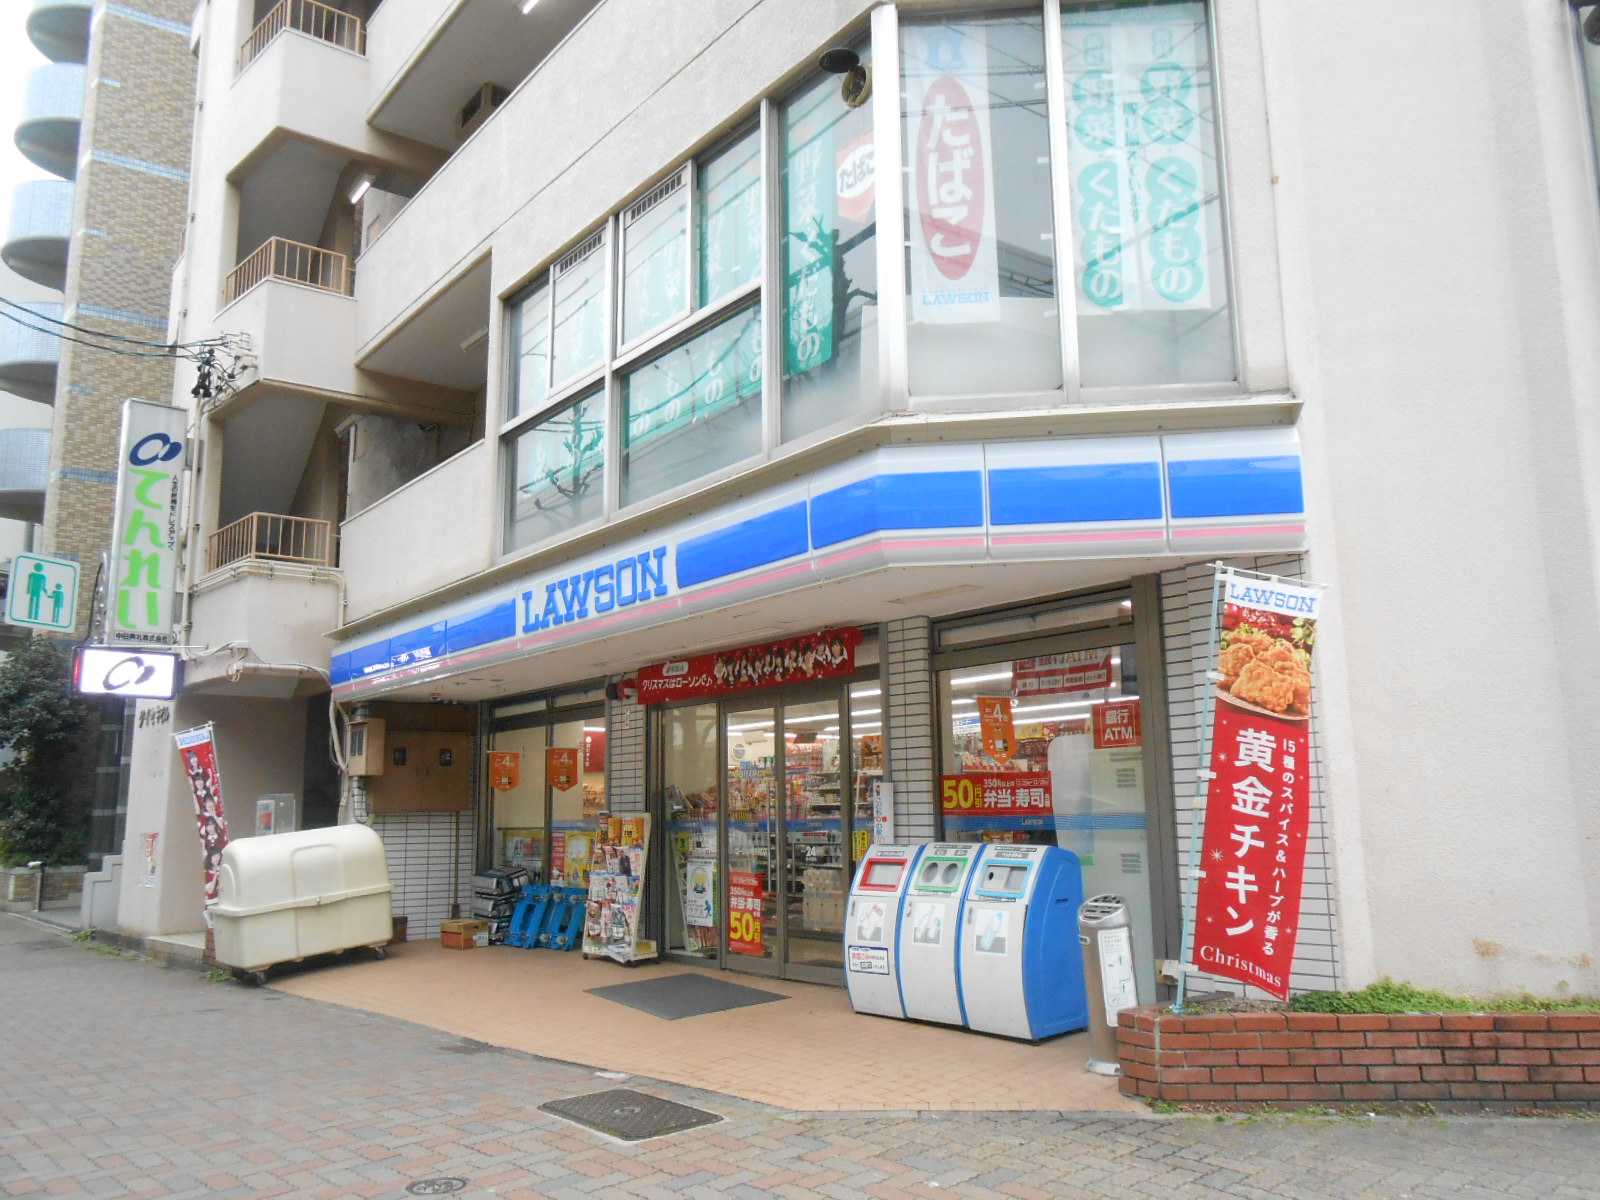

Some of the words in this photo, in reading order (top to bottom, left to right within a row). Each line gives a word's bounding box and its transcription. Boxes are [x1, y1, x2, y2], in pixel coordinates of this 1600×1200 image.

[925, 95, 973, 257] たばこ
[922, 290, 989, 305] LAWSON
[117, 467, 170, 630] てんれい
[521, 547, 668, 635] LAWSON
[1230, 583, 1318, 614] LAWSON
[1105, 708, 1129, 725] 銀行
[1104, 727, 1134, 742] ATM
[943, 778, 974, 809] 50
[983, 787, 1045, 809] 弁当・寿司
[1223, 728, 1277, 936] 黄金チキン
[805, 845, 817, 857] 24
[729, 911, 754, 942] 50
[1200, 944, 1283, 988] Christmas
